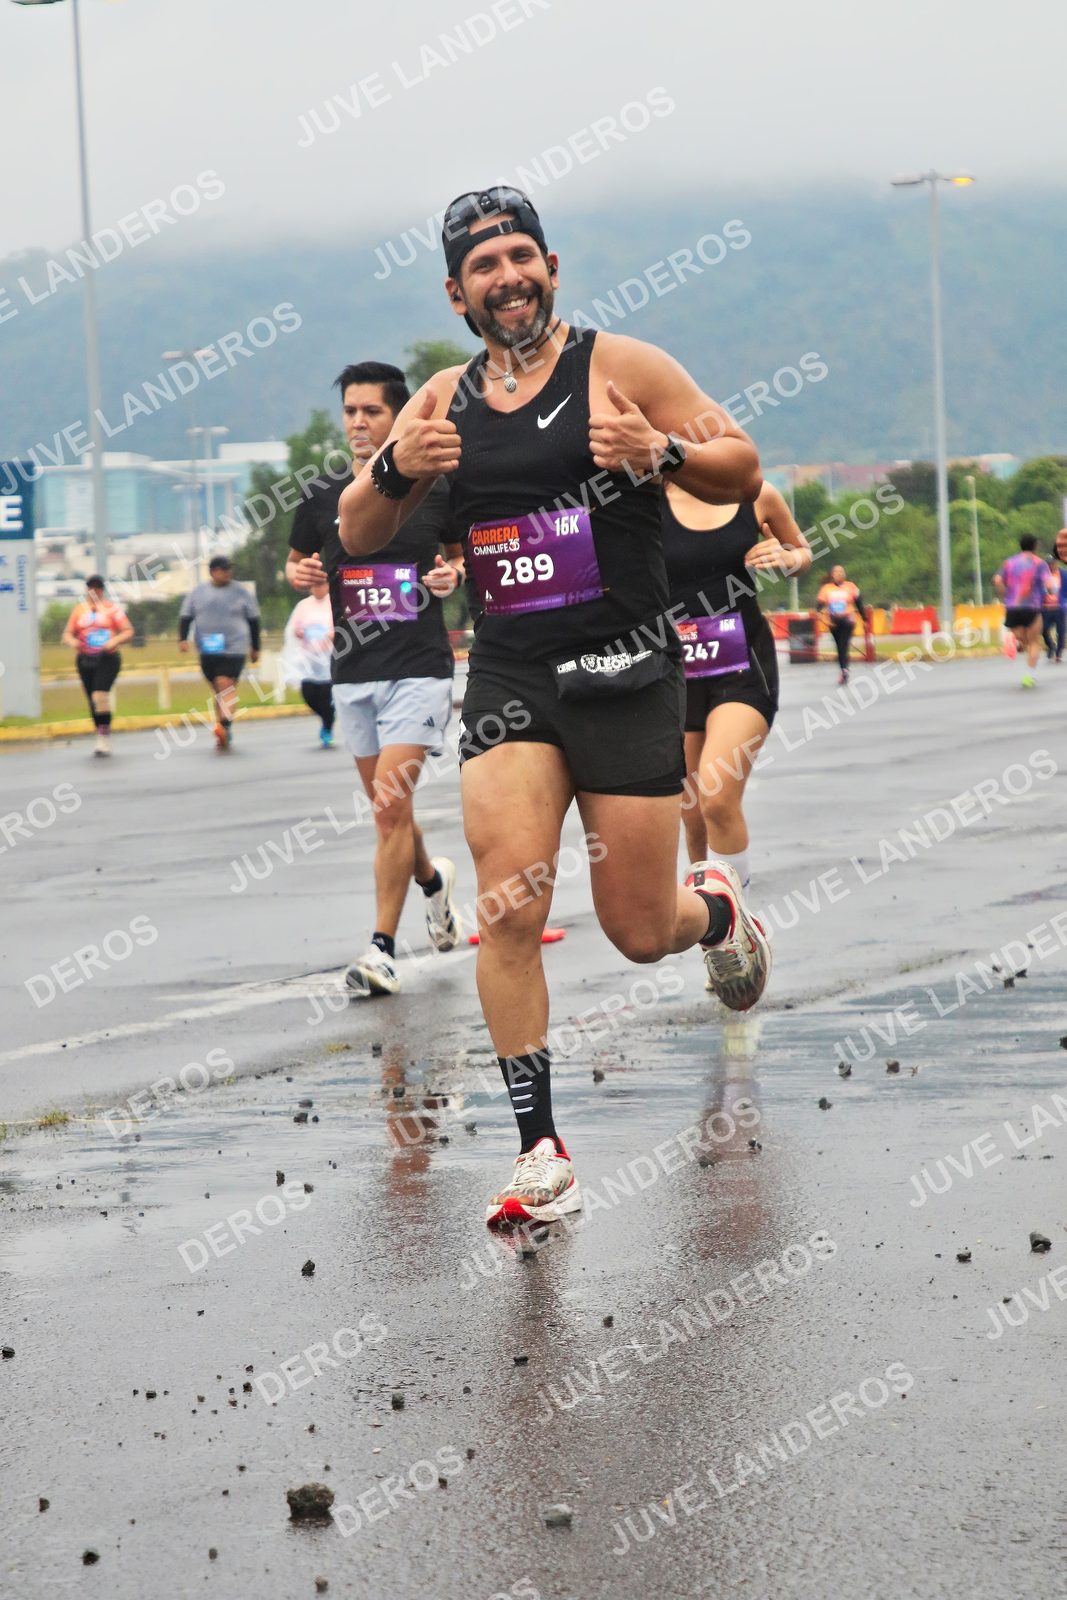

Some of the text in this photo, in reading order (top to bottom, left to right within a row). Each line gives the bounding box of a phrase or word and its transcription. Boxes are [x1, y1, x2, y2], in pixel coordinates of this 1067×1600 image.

[472, 525, 519, 545] CARRERA
[497, 553, 554, 587] 289
[357, 588, 392, 605] 132
[683, 641, 720, 662] 247
